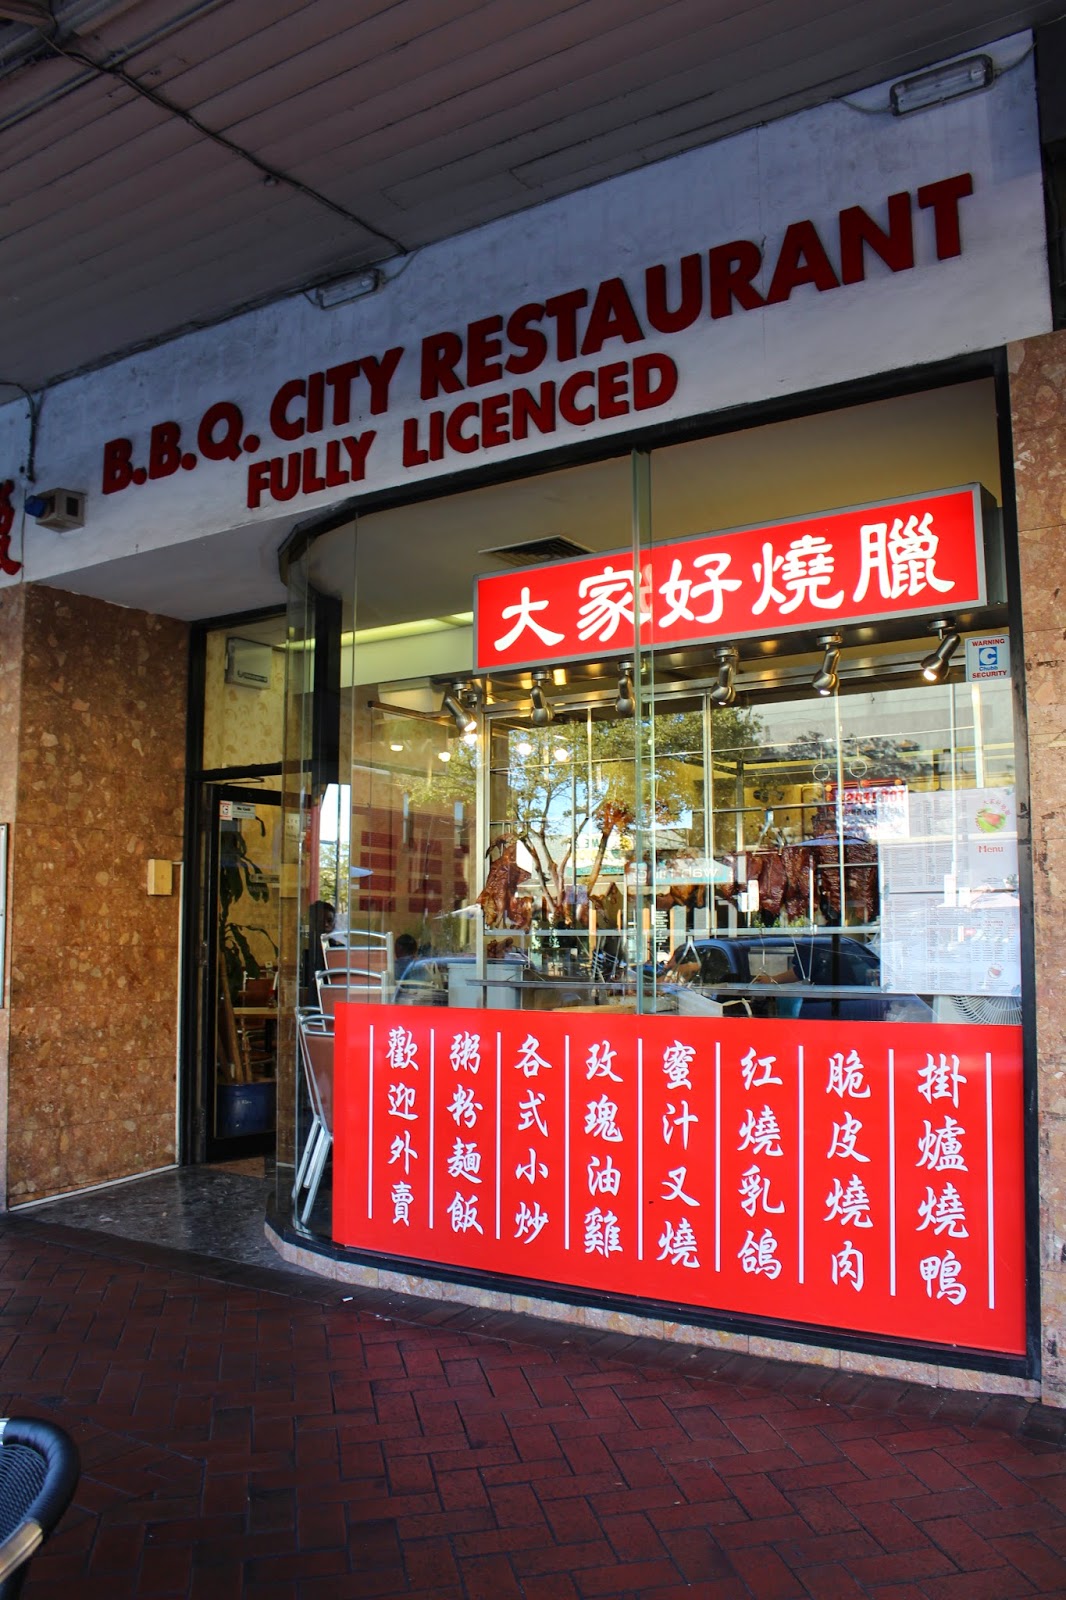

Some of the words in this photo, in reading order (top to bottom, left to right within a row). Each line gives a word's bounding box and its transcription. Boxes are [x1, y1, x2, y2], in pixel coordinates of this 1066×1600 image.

[104, 405, 259, 493] B.B.Q.
[272, 351, 400, 440] CITY
[422, 174, 971, 399] RESTAURANT
[248, 432, 375, 508] FULLY
[404, 354, 677, 466] LICENCED
[971, 638, 1005, 647] WARNING
[972, 670, 1007, 679] SECURITY
[978, 845, 1004, 853] Menu
[386, 1026, 419, 1227] 歡迎外賣
[514, 1033, 553, 1244] 各式小炒
[584, 1040, 624, 1259] 玫瑰油雞
[656, 1040, 701, 1269] 蜜汁叉燒
[823, 1049, 874, 1292] 脆皮燒肉
[916, 1053, 970, 1306] 掛爐燒鴨
